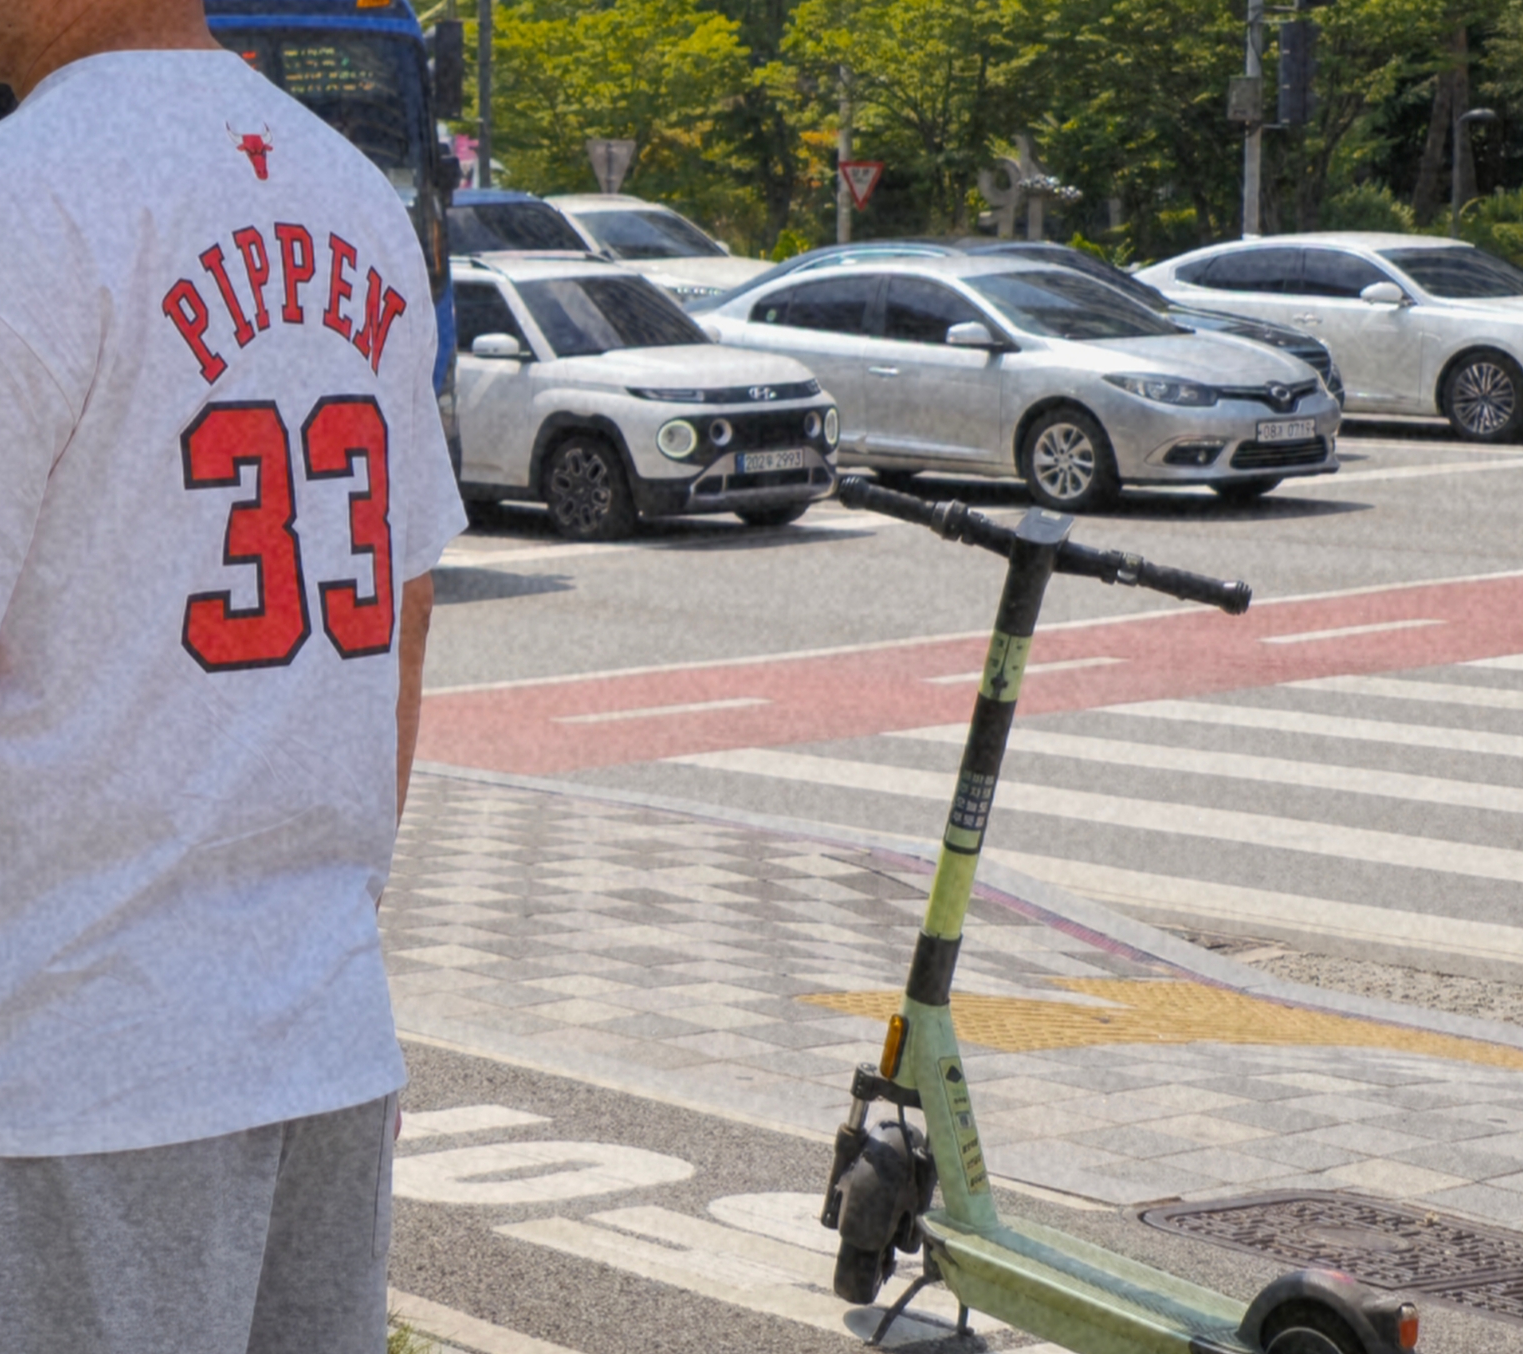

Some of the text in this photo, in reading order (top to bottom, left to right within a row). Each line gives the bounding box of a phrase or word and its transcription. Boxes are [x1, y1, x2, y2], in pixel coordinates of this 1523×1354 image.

[162, 221, 407, 385] PIPPEN
[180, 394, 396, 673] 33
[776, 451, 802, 468] 2993
